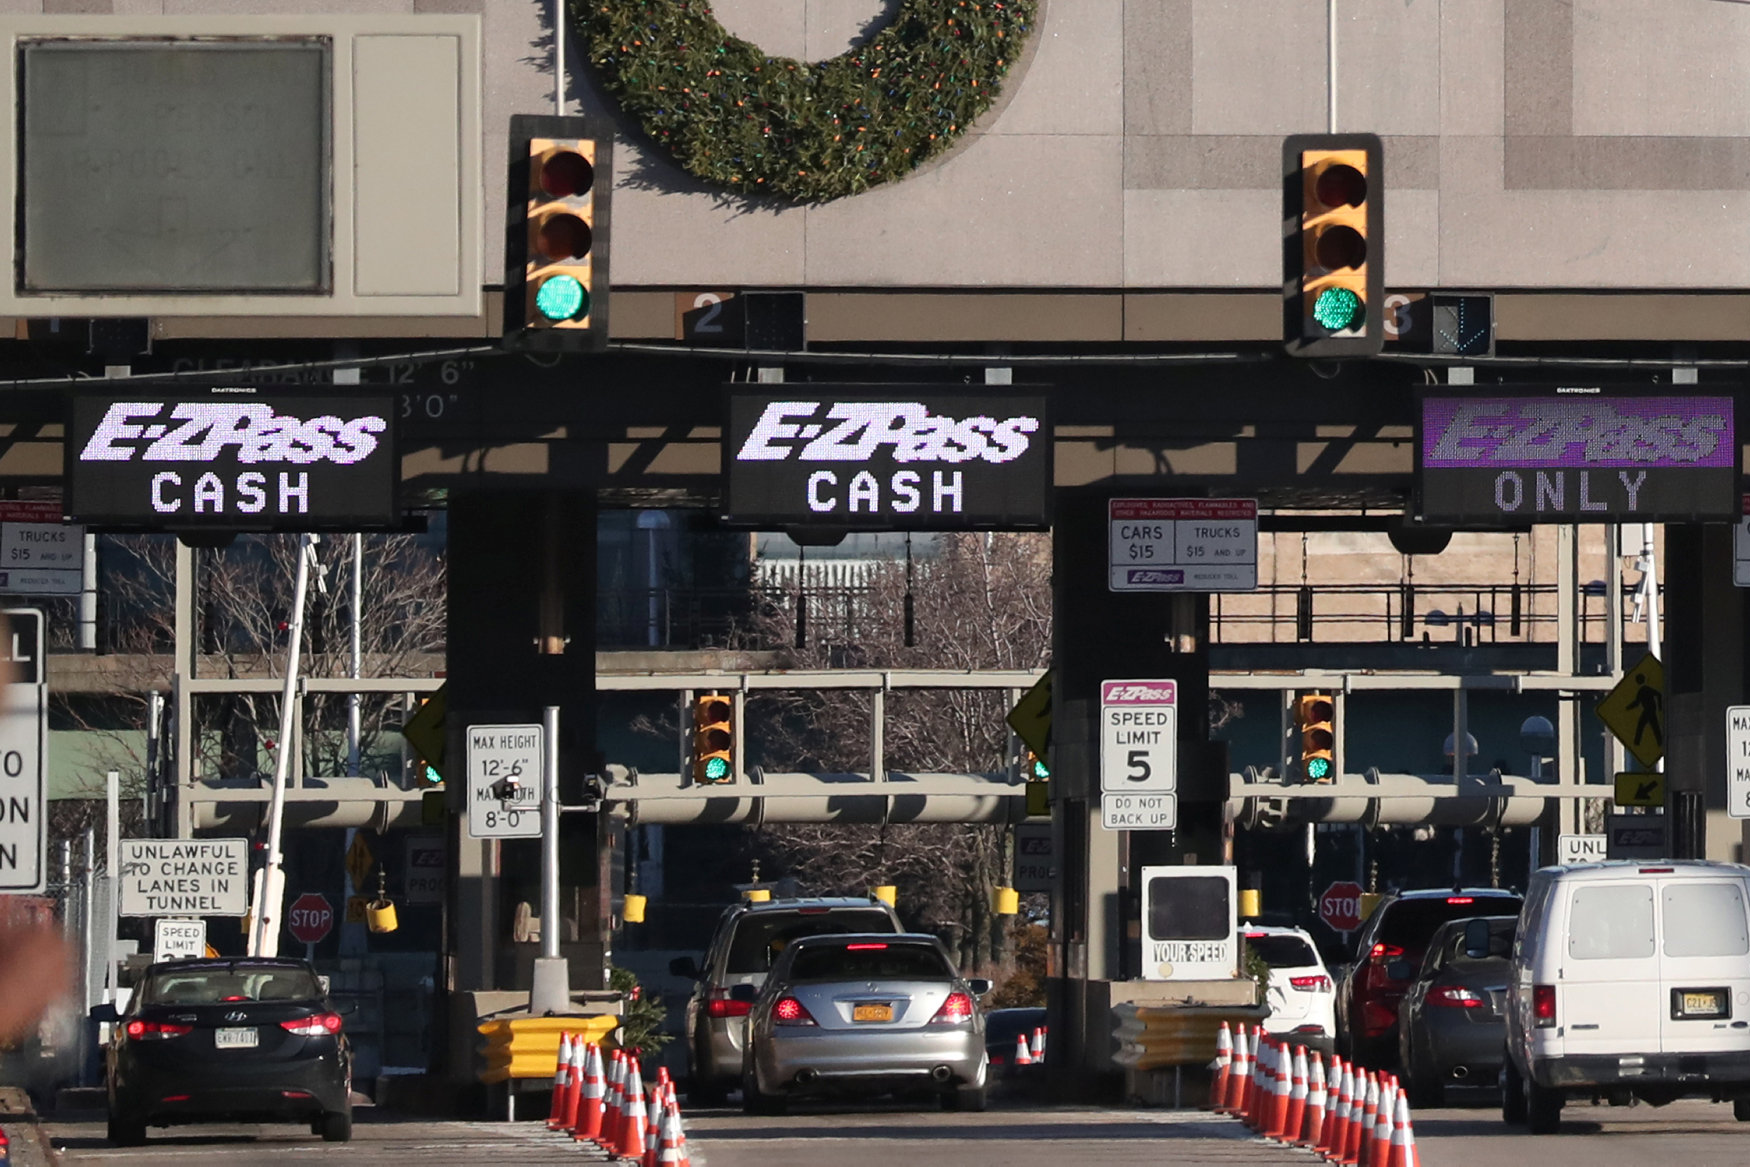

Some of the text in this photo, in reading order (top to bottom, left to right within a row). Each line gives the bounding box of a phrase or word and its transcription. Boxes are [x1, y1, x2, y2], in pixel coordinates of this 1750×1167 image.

[693, 292, 724, 332] 2
[1383, 294, 1413, 335] 3
[80, 403, 387, 464] E-ZPass
[737, 402, 1039, 463] E-ZPass
[151, 472, 309, 513] CASH
[807, 471, 963, 513] CASH
[1494, 470, 1647, 512] ONLY
[19, 530, 66, 542] TRUCKS
[1121, 526, 1163, 539] CARS
[1195, 527, 1240, 538] TRUCKS
[11, 548, 31, 560] $15
[1129, 543, 1154, 560] $15
[1186, 545, 1205, 558] $15
[1106, 686, 1172, 701] E-ZPass
[1111, 712, 1167, 726] SPEED
[473, 735, 537, 749] MAX HEIGHT
[1116, 731, 1161, 744] LIMIT
[0, 750, 22, 777] O
[482, 758, 529, 776] 12'-6"
[1127, 750, 1151, 782] 5
[1115, 798, 1162, 809] DO NOT
[486, 811, 526, 828] 8'-0"
[1111, 814, 1168, 824] BACK UP
[132, 845, 236, 859] UNLAWFUL
[131, 862, 238, 876] TO CHANGE
[138, 879, 229, 893] LANES IN
[147, 896, 221, 910] TUNNEL
[292, 910, 331, 927] STOP
[162, 928, 200, 937] SPEED
[165, 941, 195, 950] LIMIT
[1154, 943, 1227, 962] YOUR SPEED
